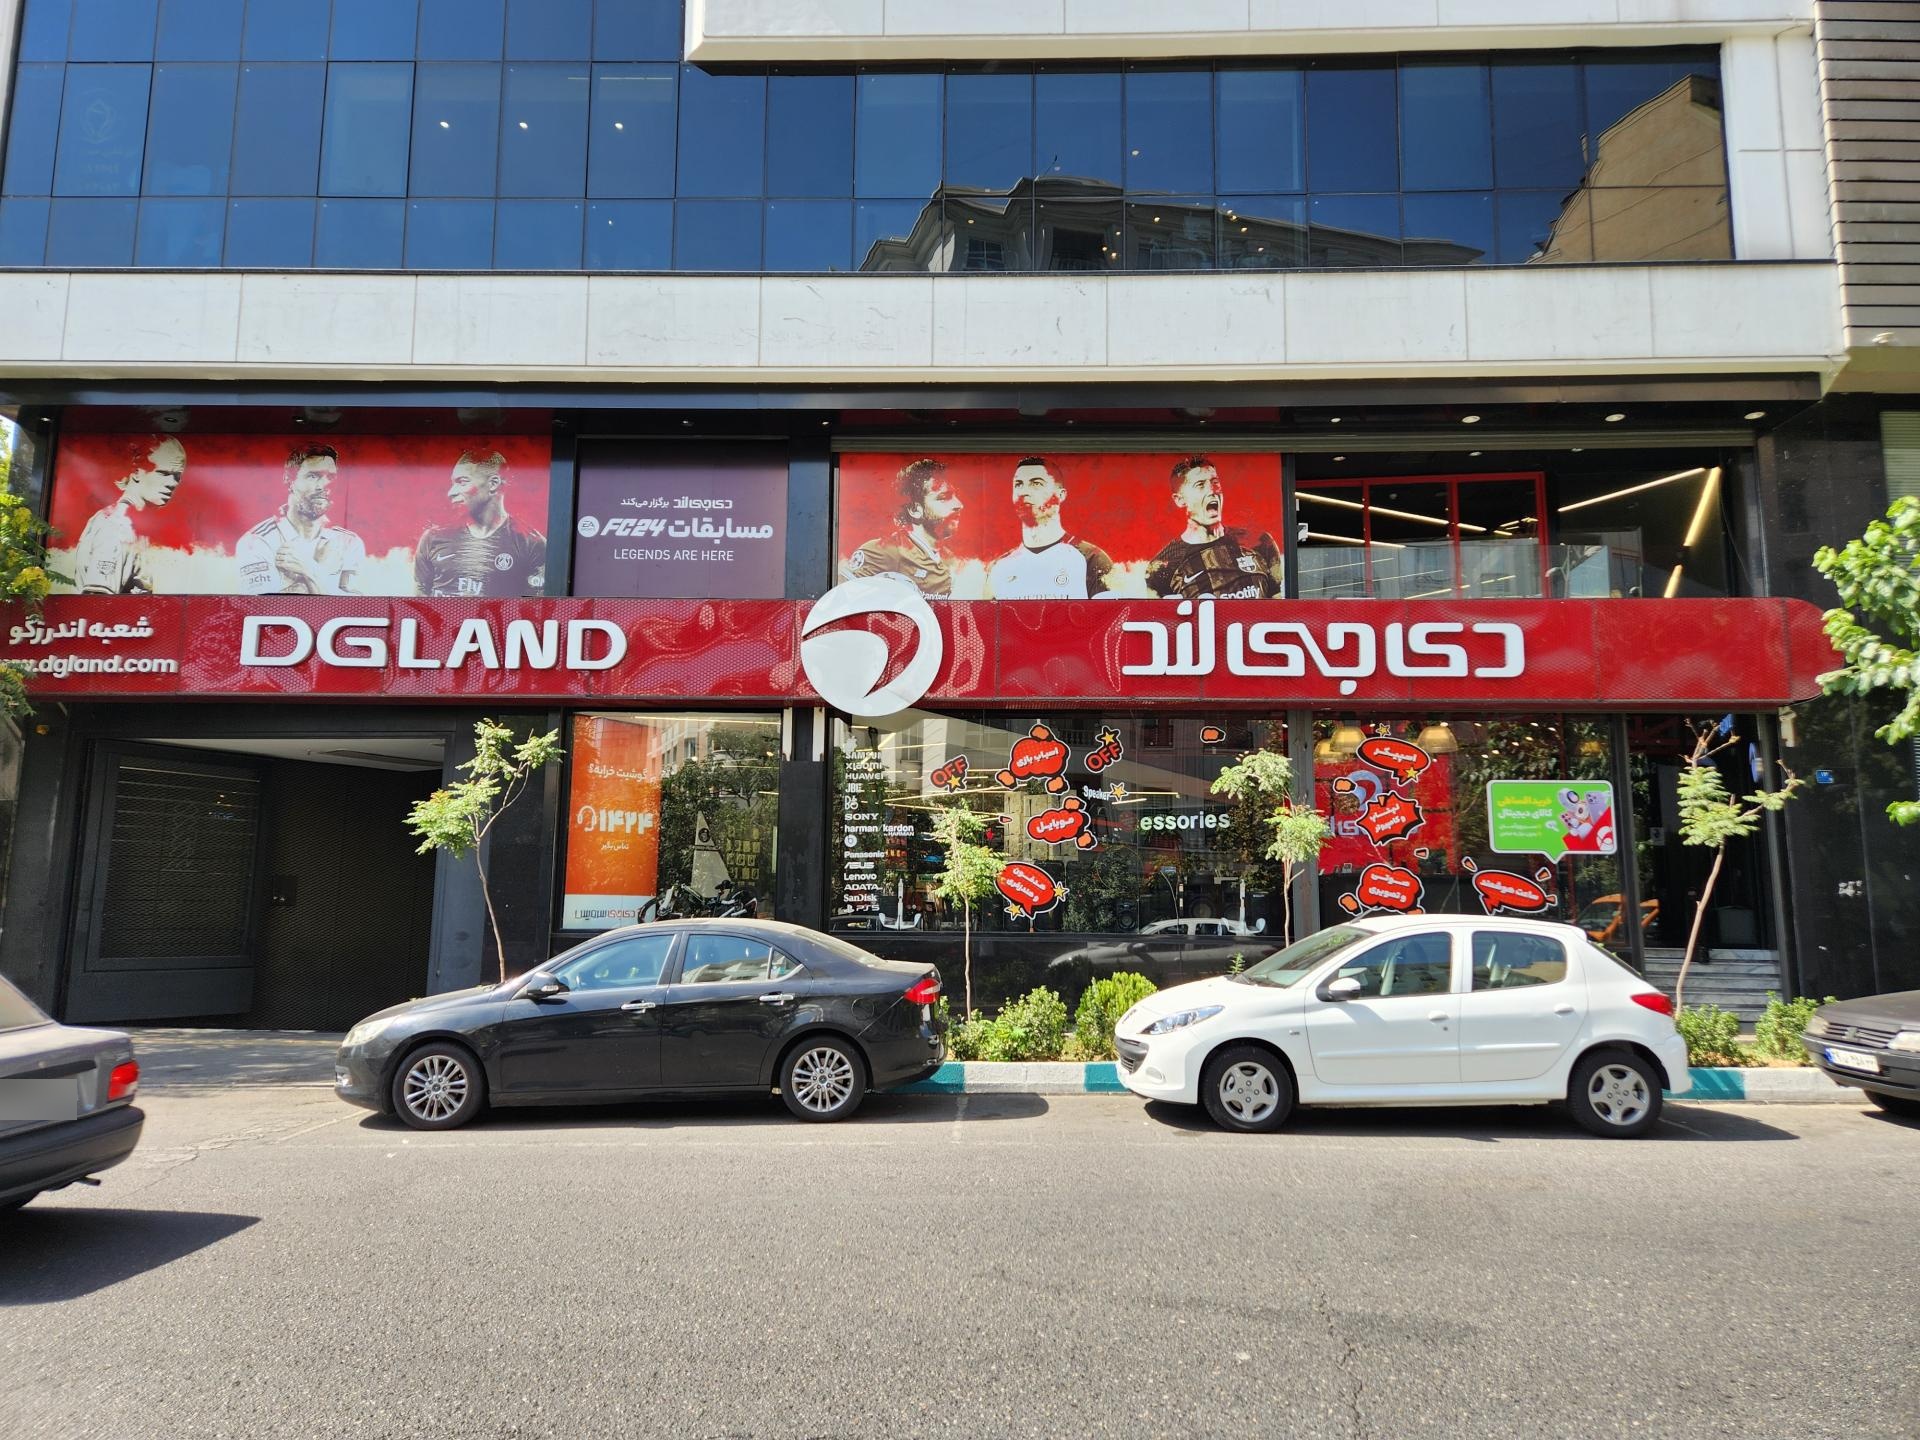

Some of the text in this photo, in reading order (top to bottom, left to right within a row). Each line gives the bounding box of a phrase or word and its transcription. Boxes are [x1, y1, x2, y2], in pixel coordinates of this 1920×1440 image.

[648, 497, 670, 508] برگزار
[668, 517, 774, 544] مسابقات
[613, 548, 735, 561] LEGENDS ARE HERE
[9, 614, 154, 645] شعبه اندرزگو
[240, 615, 628, 671] DGLAND
[1086, 741, 1120, 770] OFF
[931, 757, 966, 787] OFF
[1083, 785, 1111, 801] Speaker
[844, 850, 885, 858] Panasonic
[844, 861, 875, 869] ASUS
[843, 873, 877, 881] Lenovo
[844, 883, 879, 891] ADATA
[843, 893, 878, 902] SanDisk
[856, 904, 880, 912] PS5
